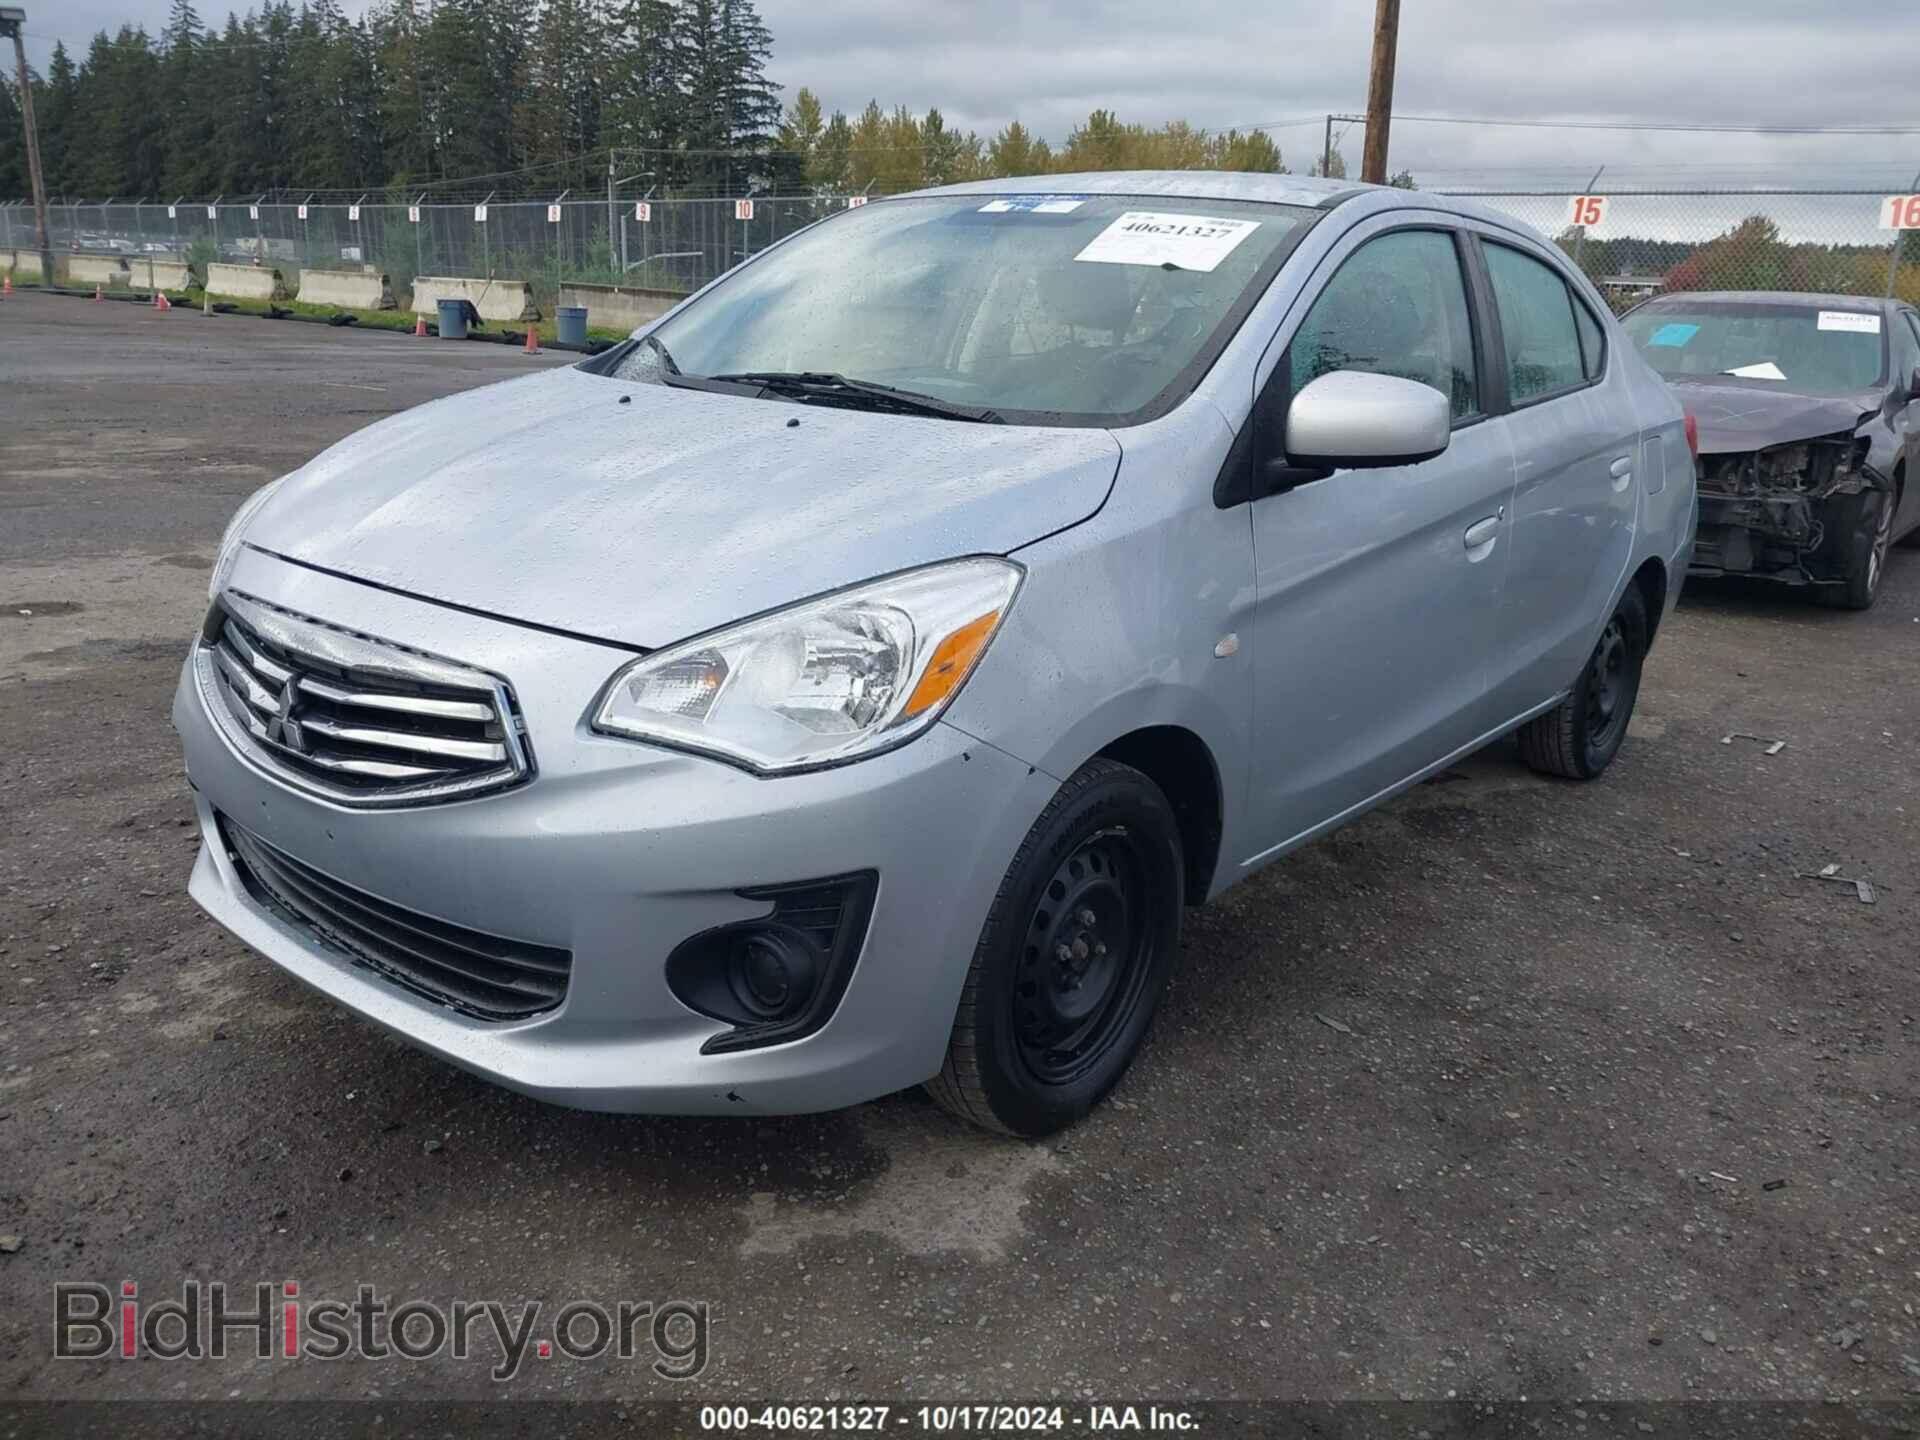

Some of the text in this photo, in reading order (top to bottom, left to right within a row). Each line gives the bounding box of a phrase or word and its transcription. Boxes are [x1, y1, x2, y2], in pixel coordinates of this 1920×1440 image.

[640, 204, 647, 219] 9
[739, 200, 751, 218] 10
[1572, 197, 1603, 225] 15
[1891, 196, 1920, 228] 16
[1121, 222, 1233, 239] 40621327
